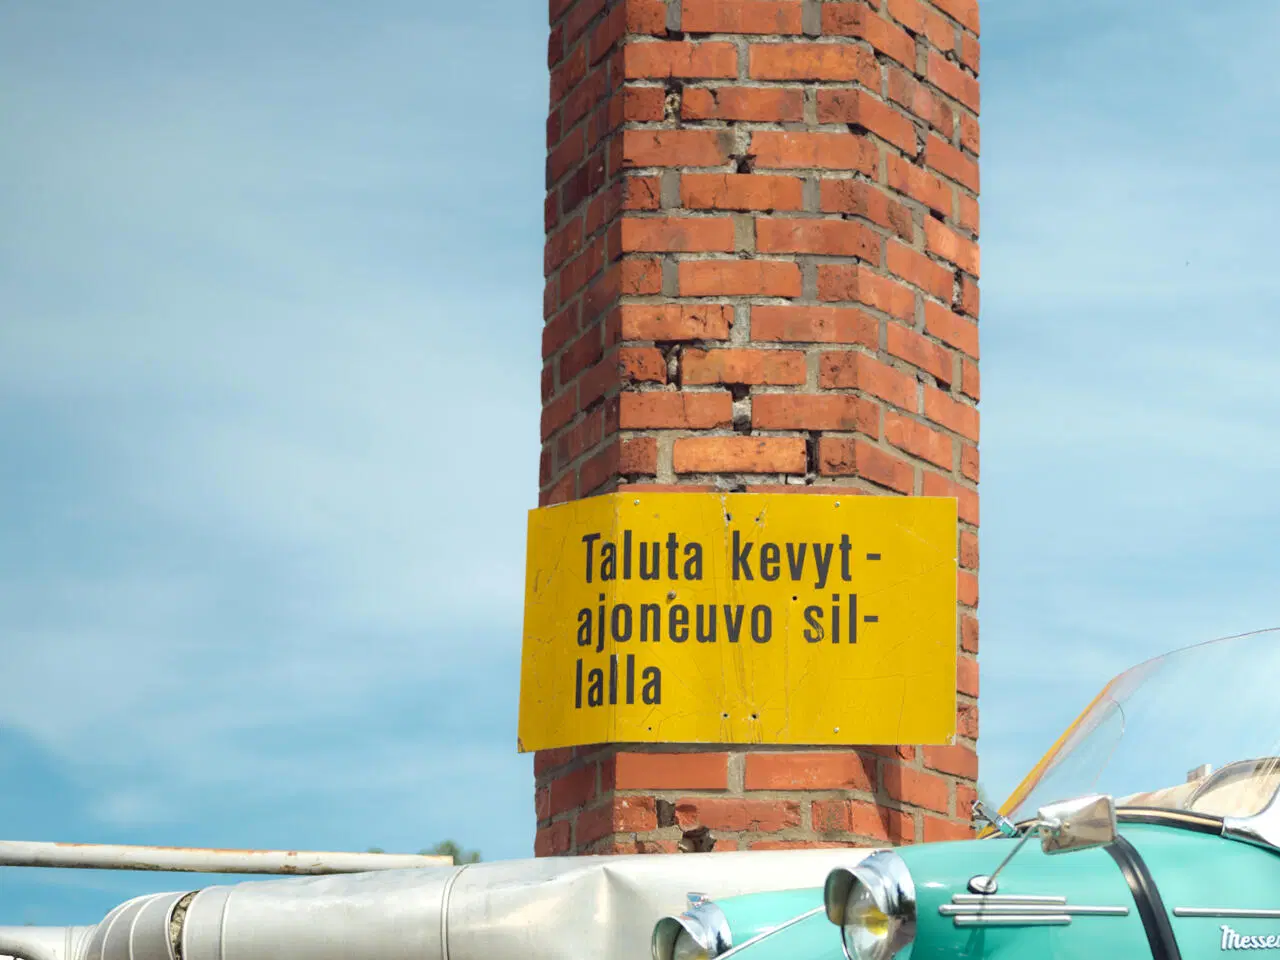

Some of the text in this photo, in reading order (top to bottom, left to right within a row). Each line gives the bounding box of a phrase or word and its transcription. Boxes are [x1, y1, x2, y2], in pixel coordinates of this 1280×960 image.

[582, 529, 703, 583] Taluta
[576, 593, 879, 654] ajoneuvo sil-
[575, 654, 662, 709] lalla
